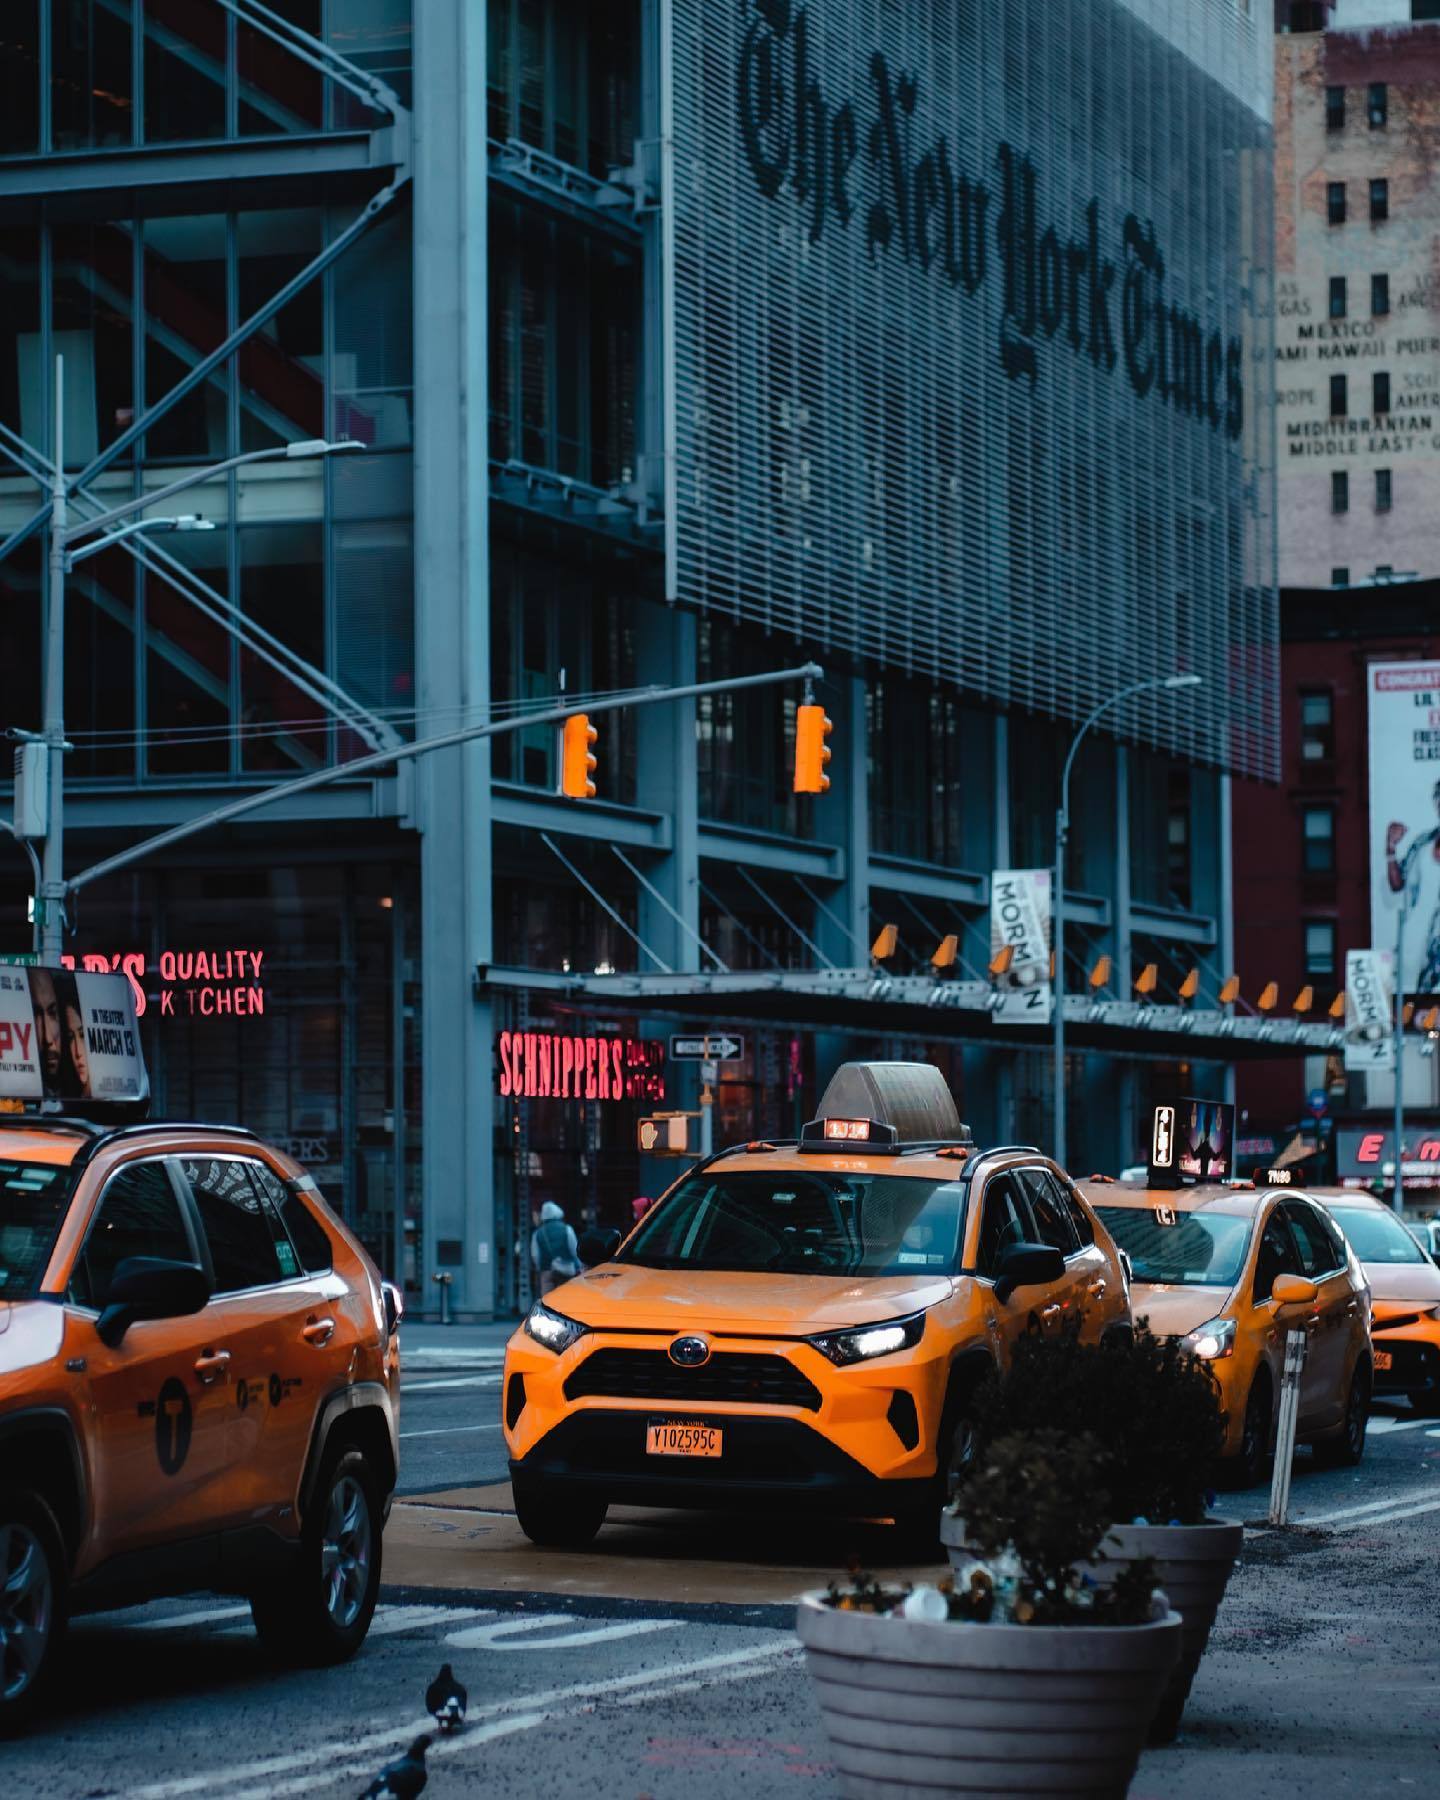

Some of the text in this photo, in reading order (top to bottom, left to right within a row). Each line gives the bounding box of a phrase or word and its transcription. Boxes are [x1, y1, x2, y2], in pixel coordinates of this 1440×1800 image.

[864, 52, 990, 298] New
[996, 142, 1118, 396] York
[1122, 212, 1244, 442] Times
[1297, 321, 1375, 339] MEXICO
[1275, 346, 1308, 361] AMI
[1289, 440, 1357, 457] MIDDLE
[1368, 436, 1414, 453] EAST
[160, 950, 264, 981] QUALITY
[87, 1027, 136, 1056] MARCH 13
[654, 1428, 716, 1450] Y102595C
